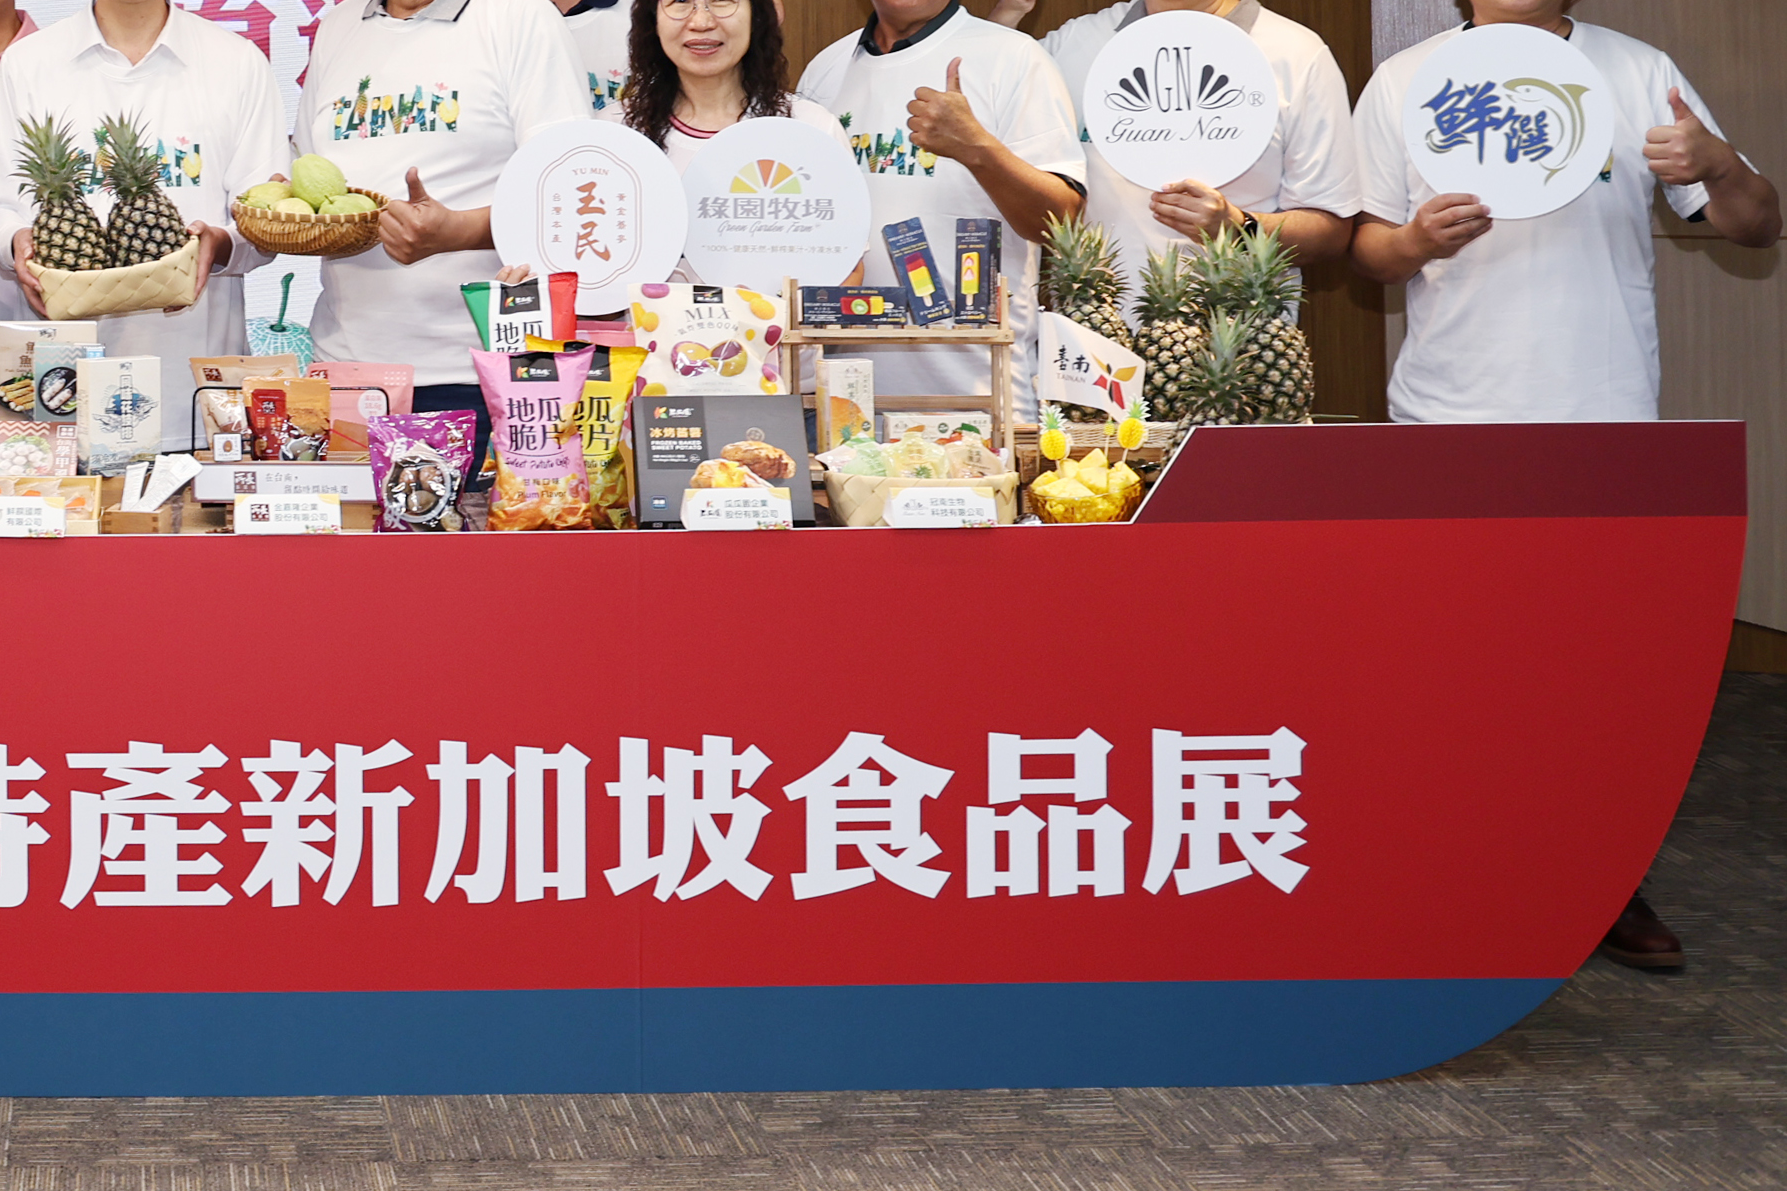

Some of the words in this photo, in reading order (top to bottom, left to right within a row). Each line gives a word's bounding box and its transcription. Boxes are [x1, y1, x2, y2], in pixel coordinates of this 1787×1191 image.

[1154, 46, 1193, 113] GN
[1105, 115, 1179, 144] Guan
[1179, 115, 1246, 142] Nan
[572, 167, 587, 176] YU
[589, 167, 610, 176] MIN
[697, 196, 836, 221] 綠園牧場
[575, 180, 612, 262] 玉民
[717, 220, 747, 237] Green
[749, 220, 784, 238] Garden
[786, 221, 815, 234] Farm
[684, 306, 732, 322] MIX
[1056, 372, 1087, 384] TAINAN
[505, 396, 566, 423] 地瓜
[508, 423, 566, 452] 脆片
[274, 513, 328, 522] 股份有限公司
[724, 509, 779, 519] 股份有限公司
